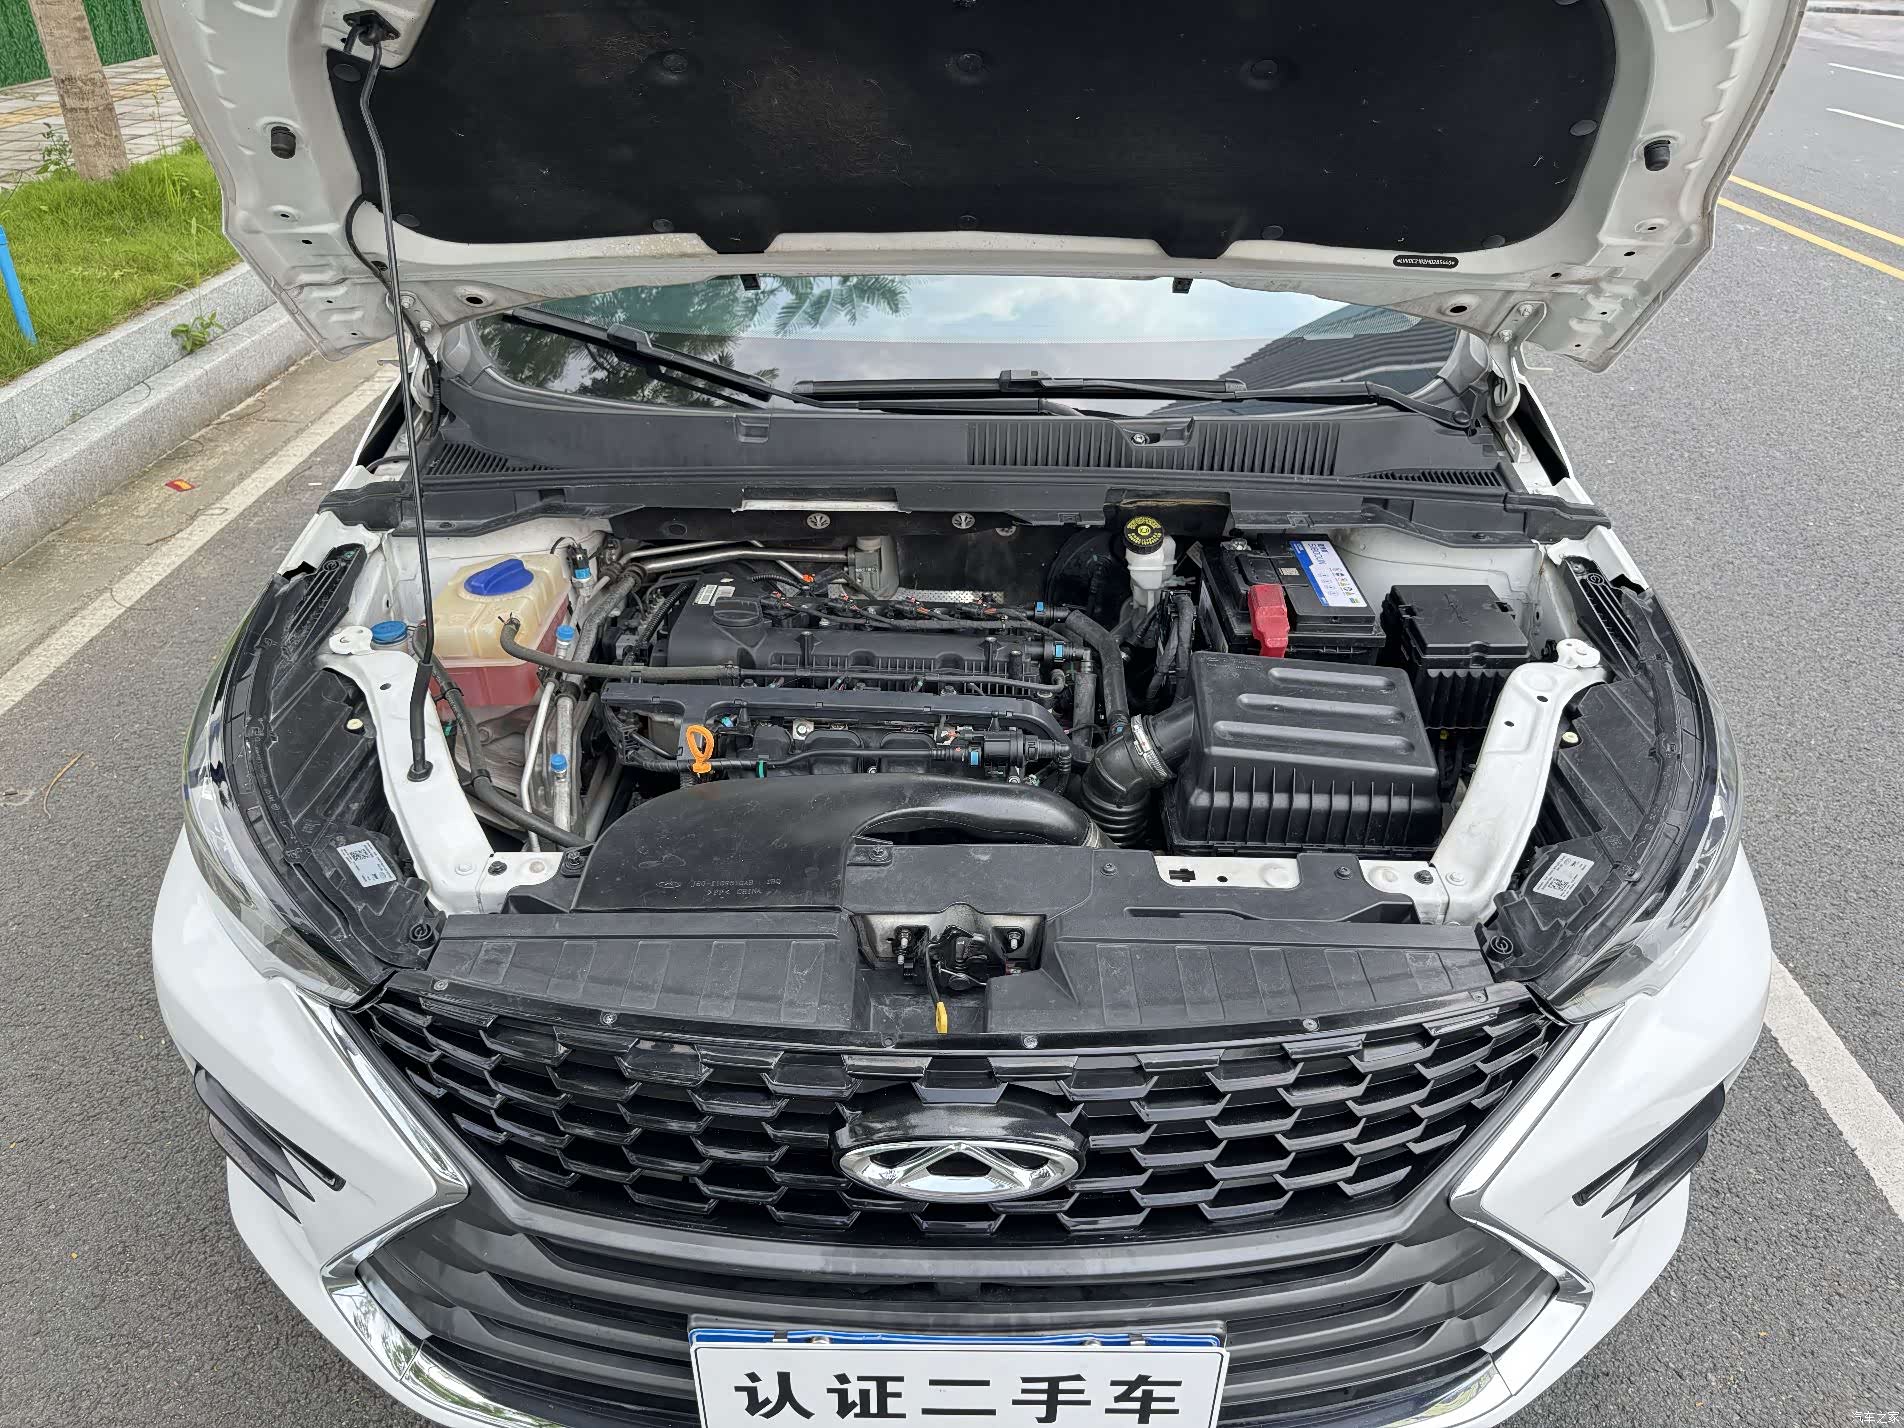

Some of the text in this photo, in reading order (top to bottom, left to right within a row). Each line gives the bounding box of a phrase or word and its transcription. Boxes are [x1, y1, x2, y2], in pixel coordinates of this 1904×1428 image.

[734, 1371, 1183, 1424] 认证二手车
